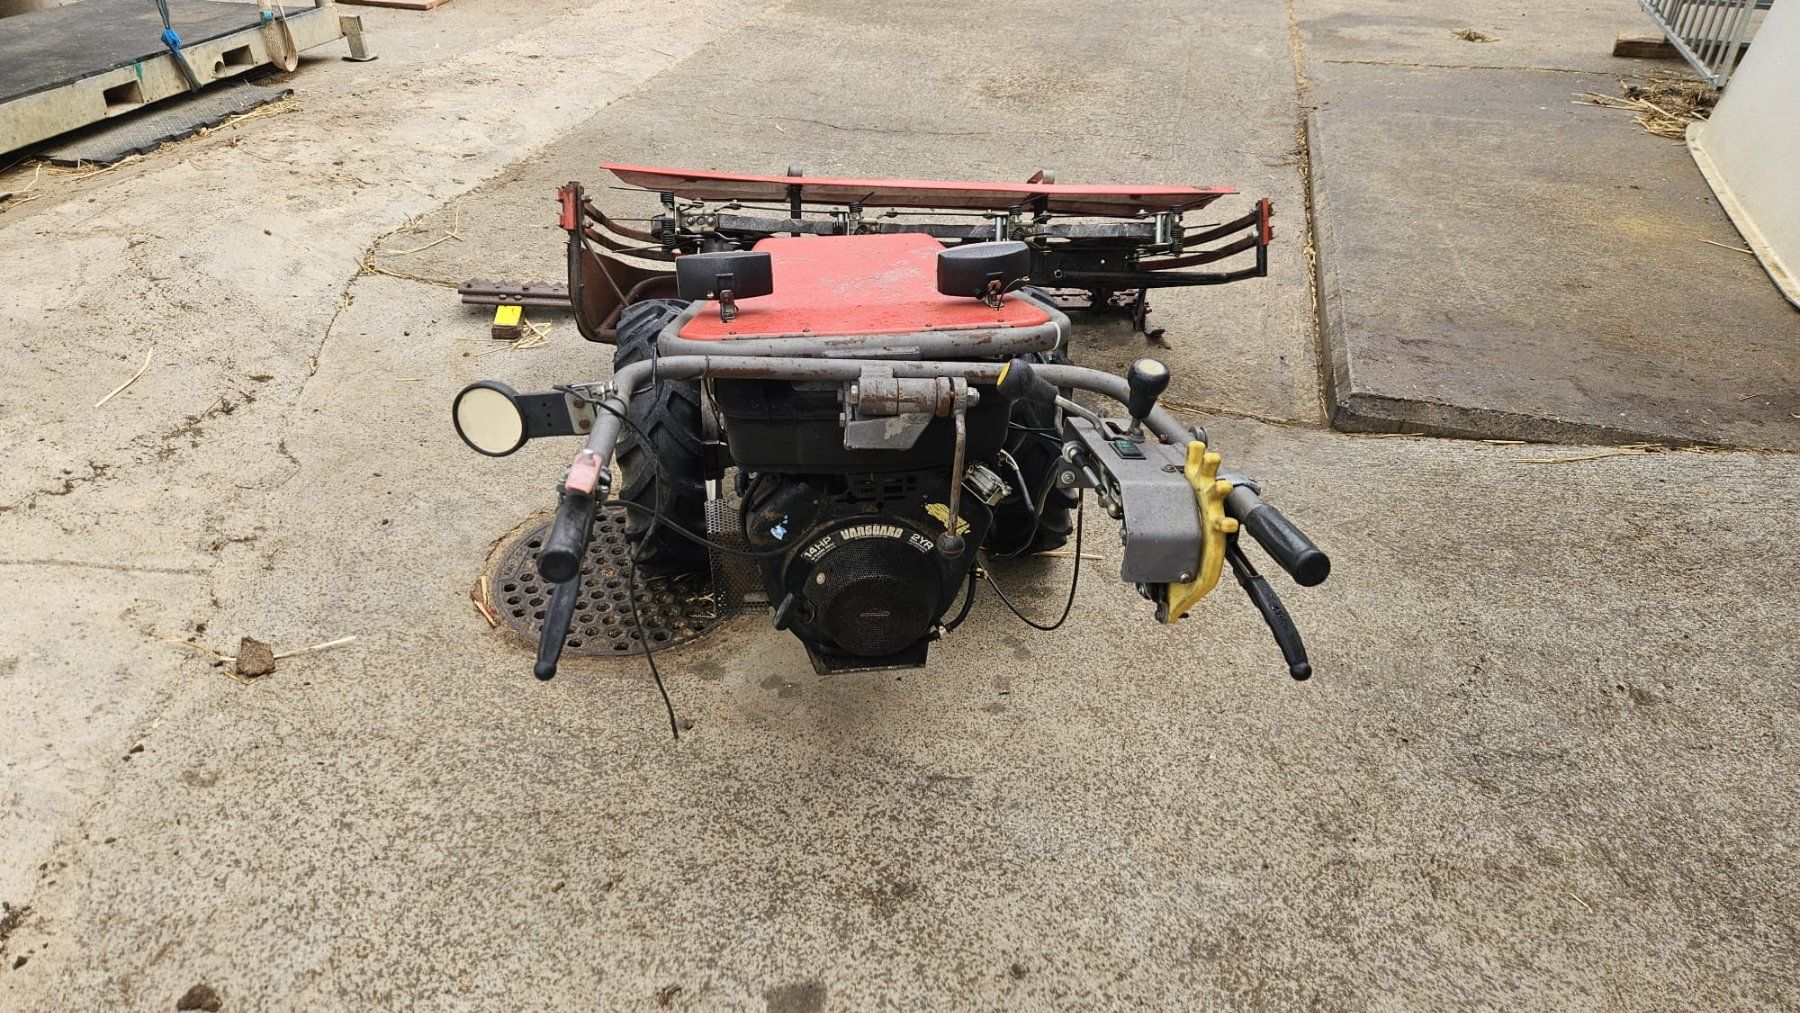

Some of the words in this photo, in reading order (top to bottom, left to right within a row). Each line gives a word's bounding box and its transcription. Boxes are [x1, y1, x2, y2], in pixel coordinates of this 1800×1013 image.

[804, 536, 831, 557] 14HP
[840, 524, 904, 541] VANGUARD
[911, 533, 934, 550] 2YR
